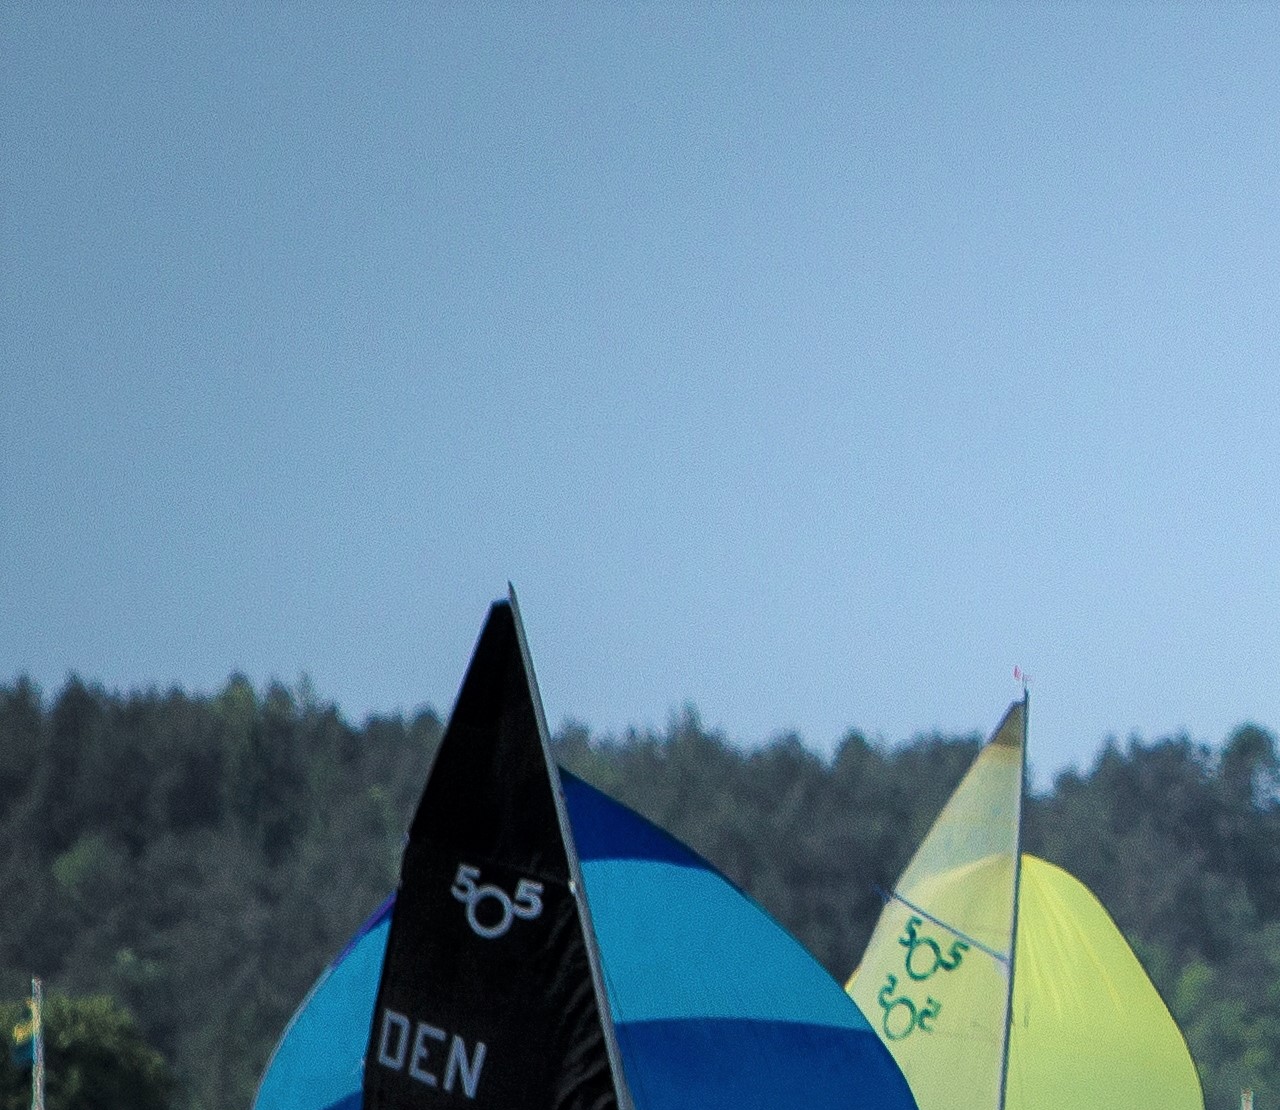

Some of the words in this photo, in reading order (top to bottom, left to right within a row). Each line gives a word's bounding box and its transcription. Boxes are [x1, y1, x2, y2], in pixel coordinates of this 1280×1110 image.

[451, 863, 544, 938] 505
[898, 915, 969, 981] 505
[379, 1008, 487, 1098] DEN
